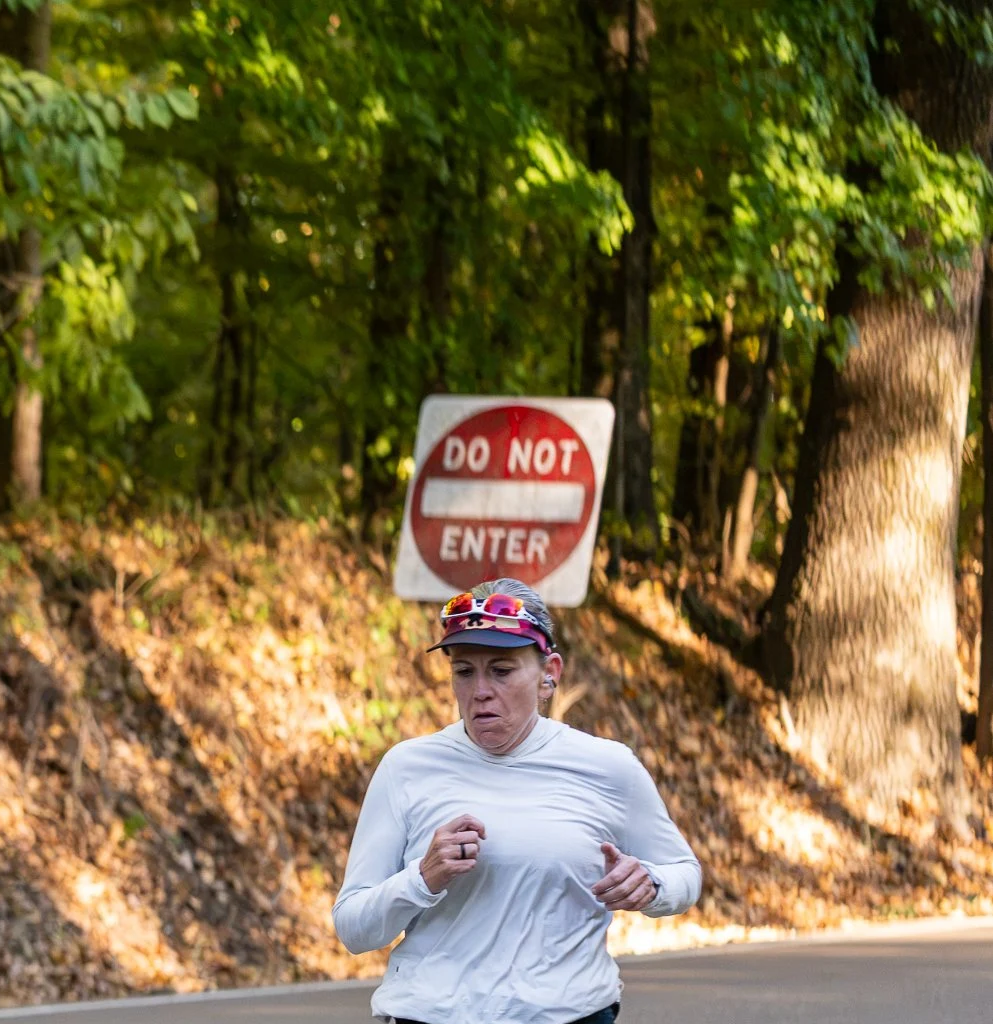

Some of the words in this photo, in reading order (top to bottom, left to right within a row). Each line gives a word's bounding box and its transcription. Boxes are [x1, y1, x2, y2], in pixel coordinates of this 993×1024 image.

[442, 435, 491, 473] DO
[507, 437, 580, 476] NOT
[439, 525, 551, 564] ENTER
